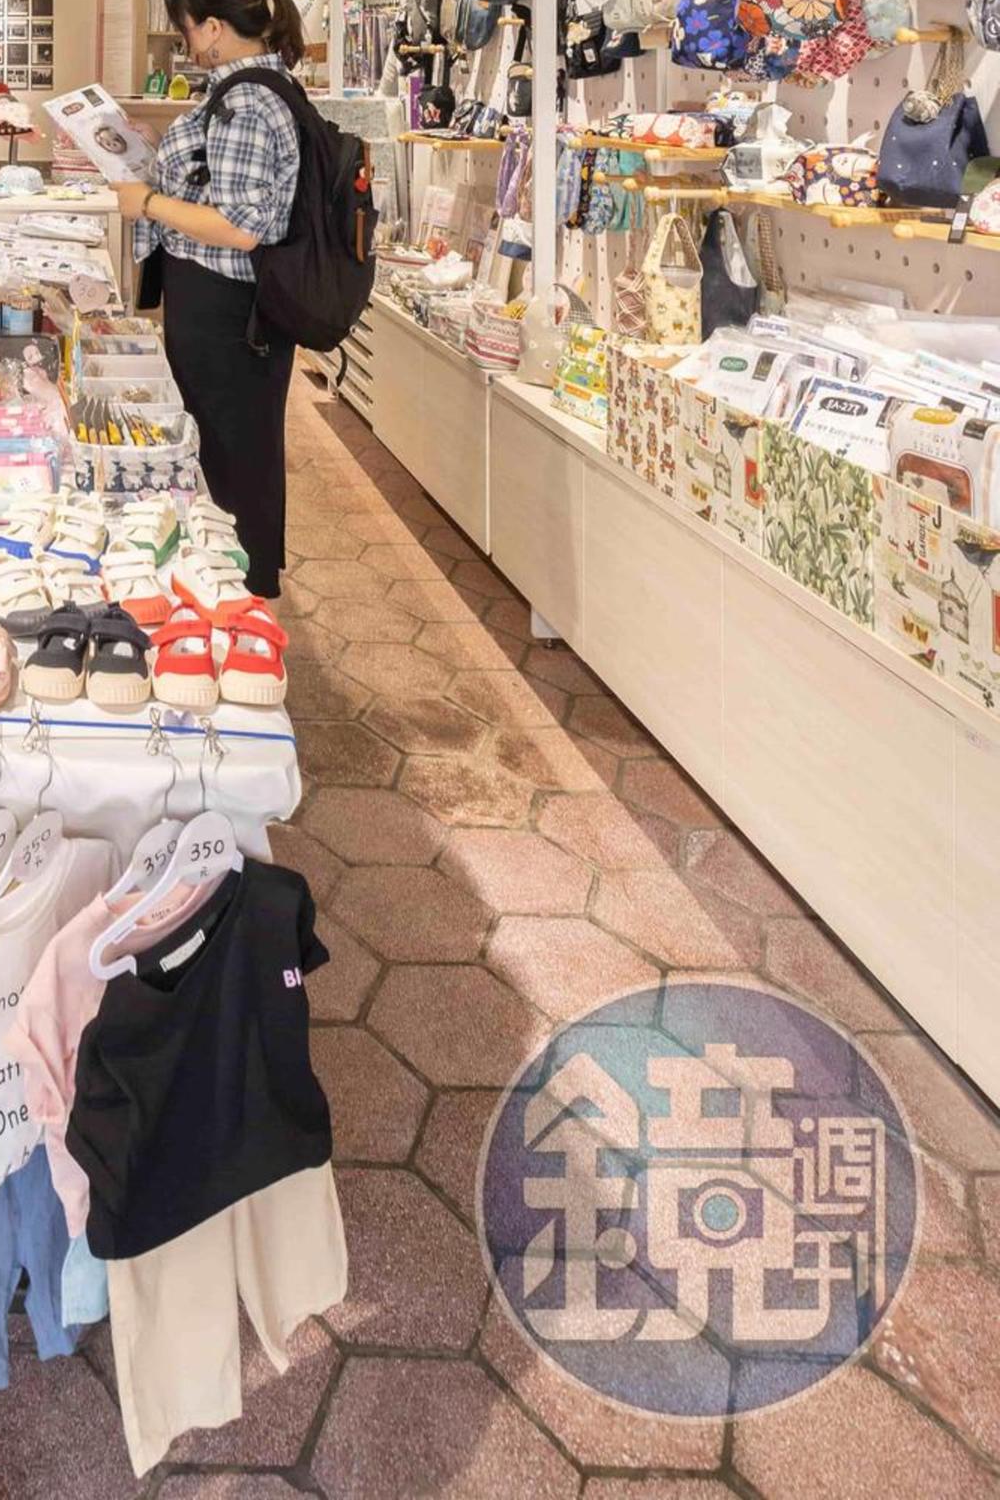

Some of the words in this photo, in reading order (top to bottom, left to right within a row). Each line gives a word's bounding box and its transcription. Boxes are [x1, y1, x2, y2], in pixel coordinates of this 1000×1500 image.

[23, 828, 52, 865] 350
[144, 839, 178, 877] 350
[190, 839, 225, 863] 350
